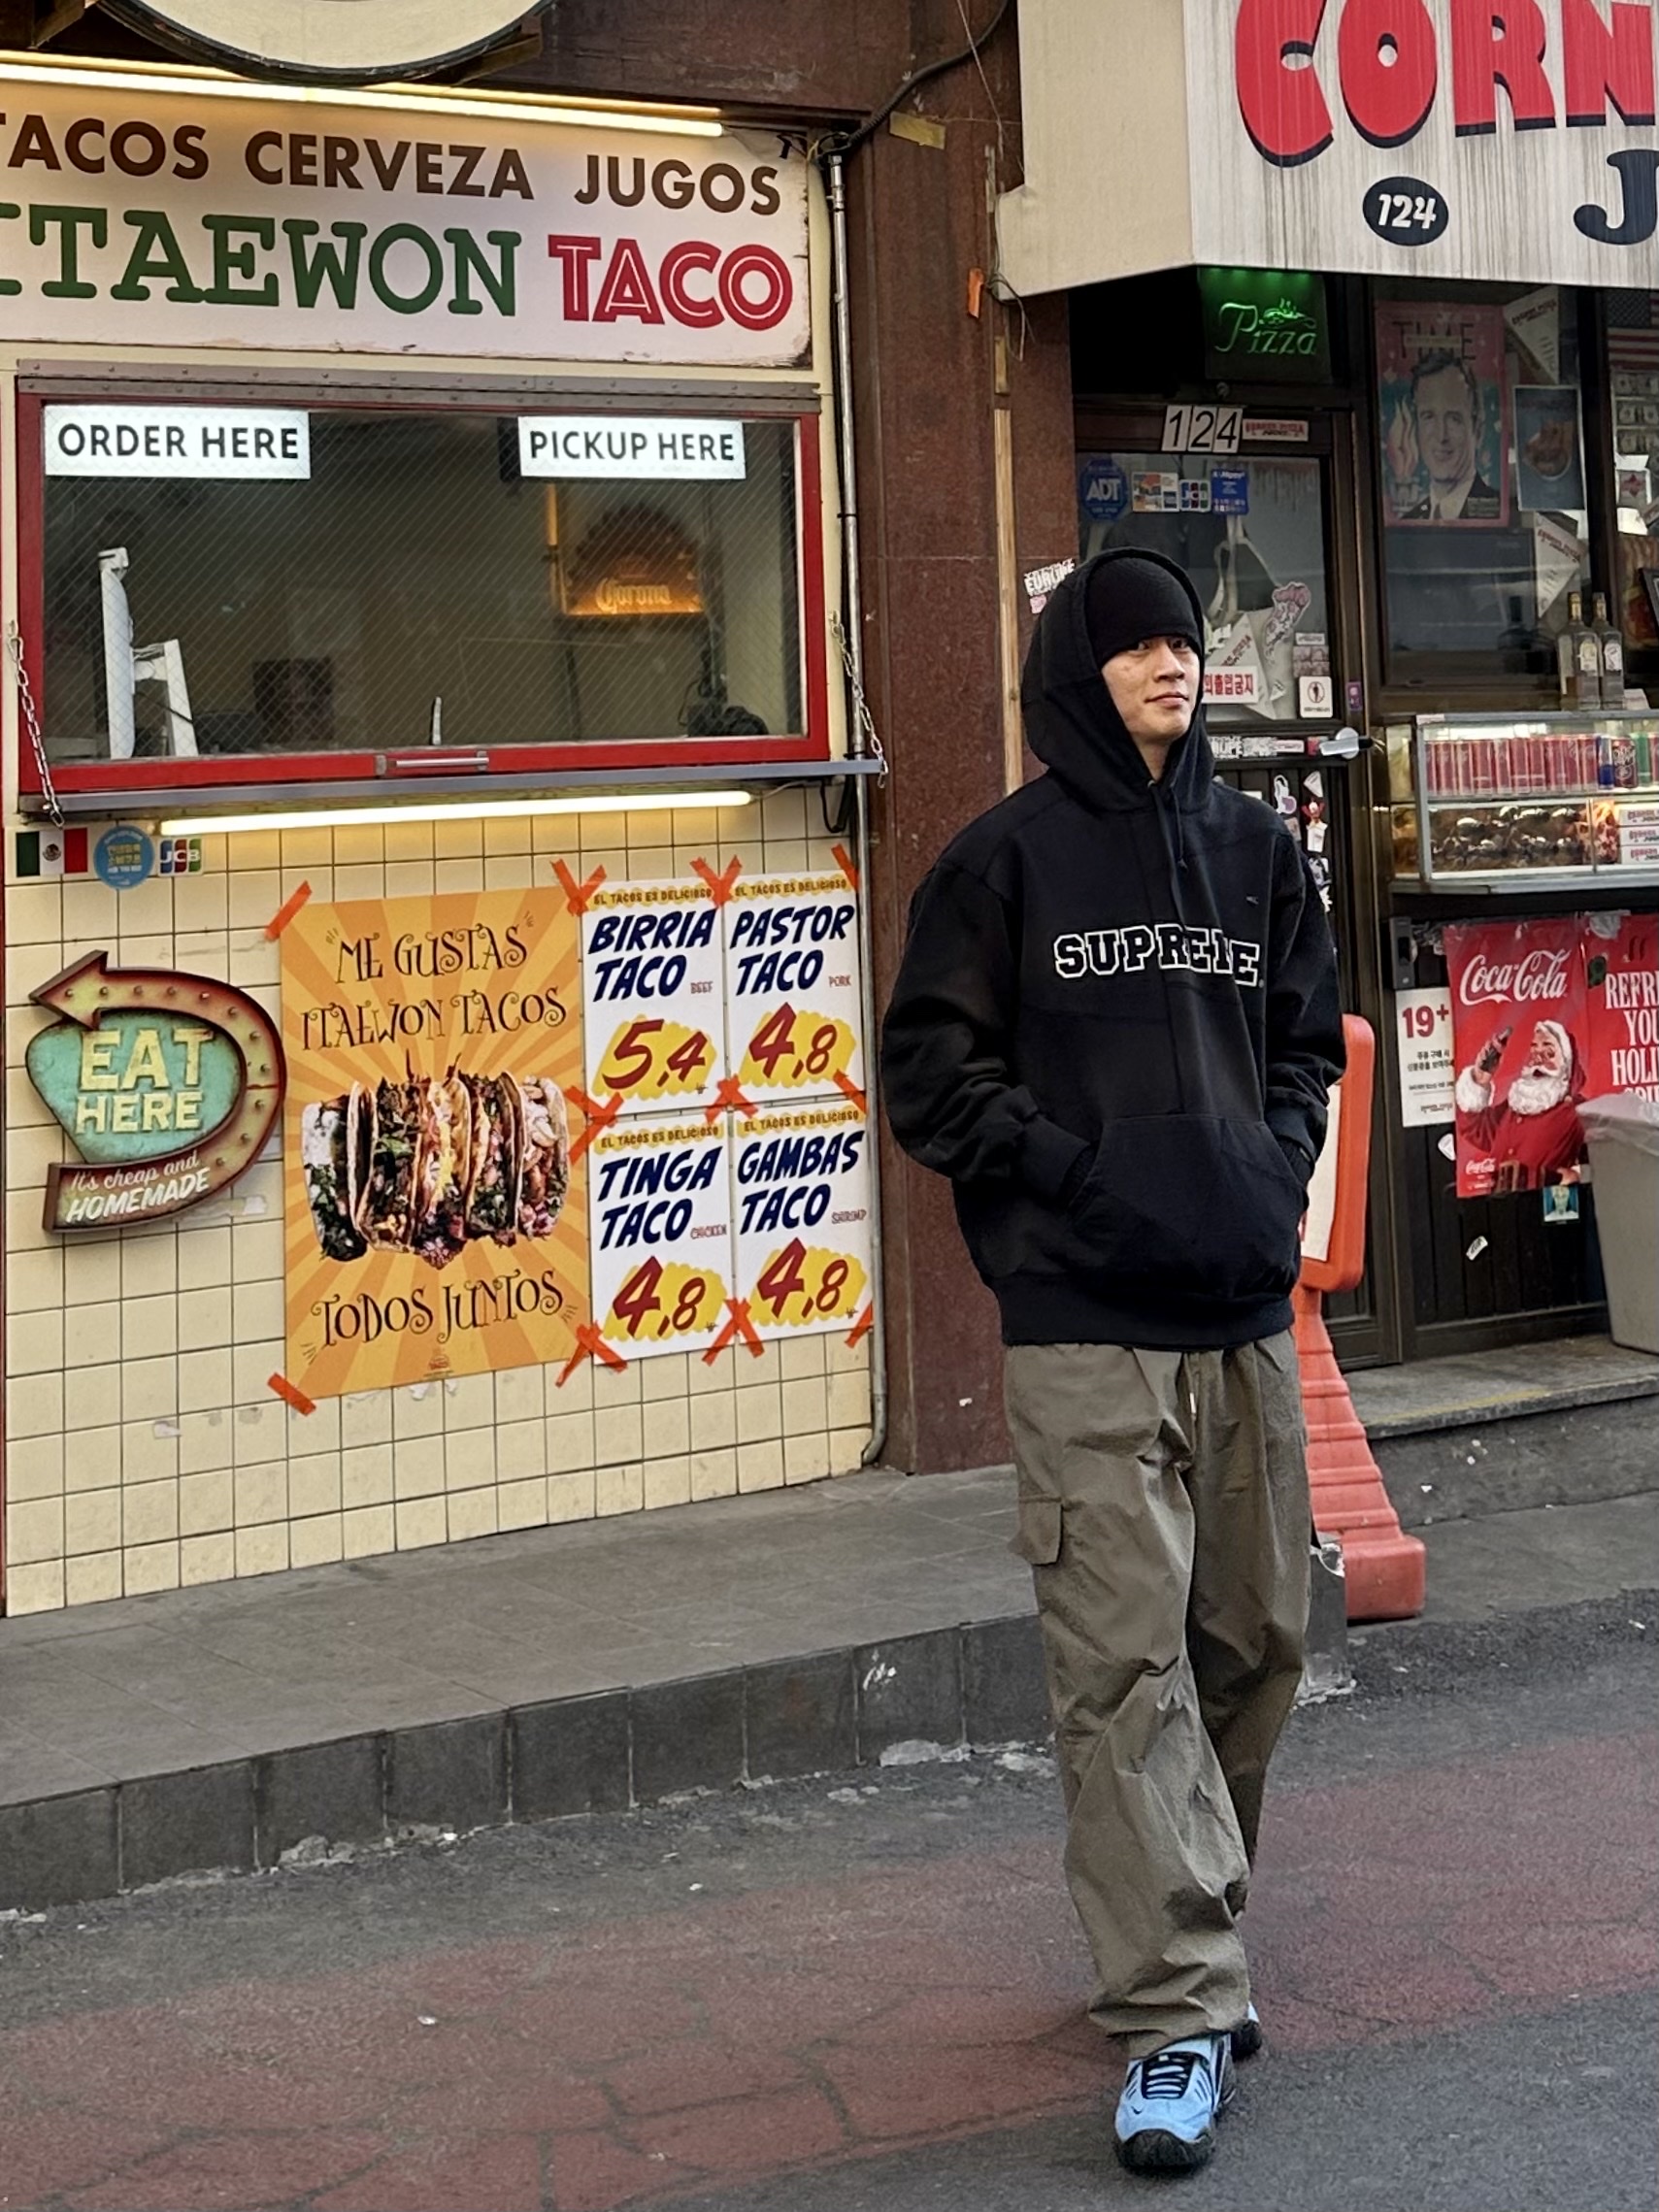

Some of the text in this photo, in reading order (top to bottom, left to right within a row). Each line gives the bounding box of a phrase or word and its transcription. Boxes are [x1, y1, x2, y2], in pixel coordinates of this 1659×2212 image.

[1235, 0, 1656, 168] CORN
[0, 113, 780, 215] ACOS CERVEZA JUGOS
[1377, 193, 1438, 228] 124
[548, 234, 794, 331] TACO
[1214, 302, 1317, 355] Pizza
[57, 422, 300, 461] ORDER HERE
[530, 430, 736, 463] PICKUP HERE
[1168, 410, 1237, 449] 124
[1086, 479, 1120, 501] ADT
[596, 577, 673, 614] Corona
[159, 849, 201, 863] JCB
[611, 892, 643, 905] TACOS
[751, 883, 780, 895] TACOS
[587, 908, 718, 954] BIRRIA
[730, 905, 855, 949] PASTOR
[335, 923, 528, 984] ME GUSTAS
[736, 949, 824, 996] TACO
[593, 955, 687, 1002] TACO
[690, 980, 713, 995] BEEF
[828, 974, 852, 987] PORK
[1459, 948, 1572, 1006] Coca-Cola
[1605, 971, 1659, 1009] REFR
[301, 985, 567, 1051] ITAEWON TACOS
[1402, 1004, 1449, 1039] 19+
[80, 1027, 214, 1092] EAT
[76, 1091, 202, 1135] HERE
[744, 1121, 756, 1132] EL
[601, 1137, 614, 1148] EL
[617, 1133, 649, 1145] TACOS
[738, 1130, 865, 1185] GAMBAS
[71, 1149, 200, 1191] It's cheap and
[597, 1145, 723, 1202] TINGA
[65, 1167, 211, 1224] HOMEMADE
[740, 1183, 831, 1235] TACO
[599, 1198, 693, 1251] TACO
[311, 1269, 564, 1348] TODOS JUNTOS
